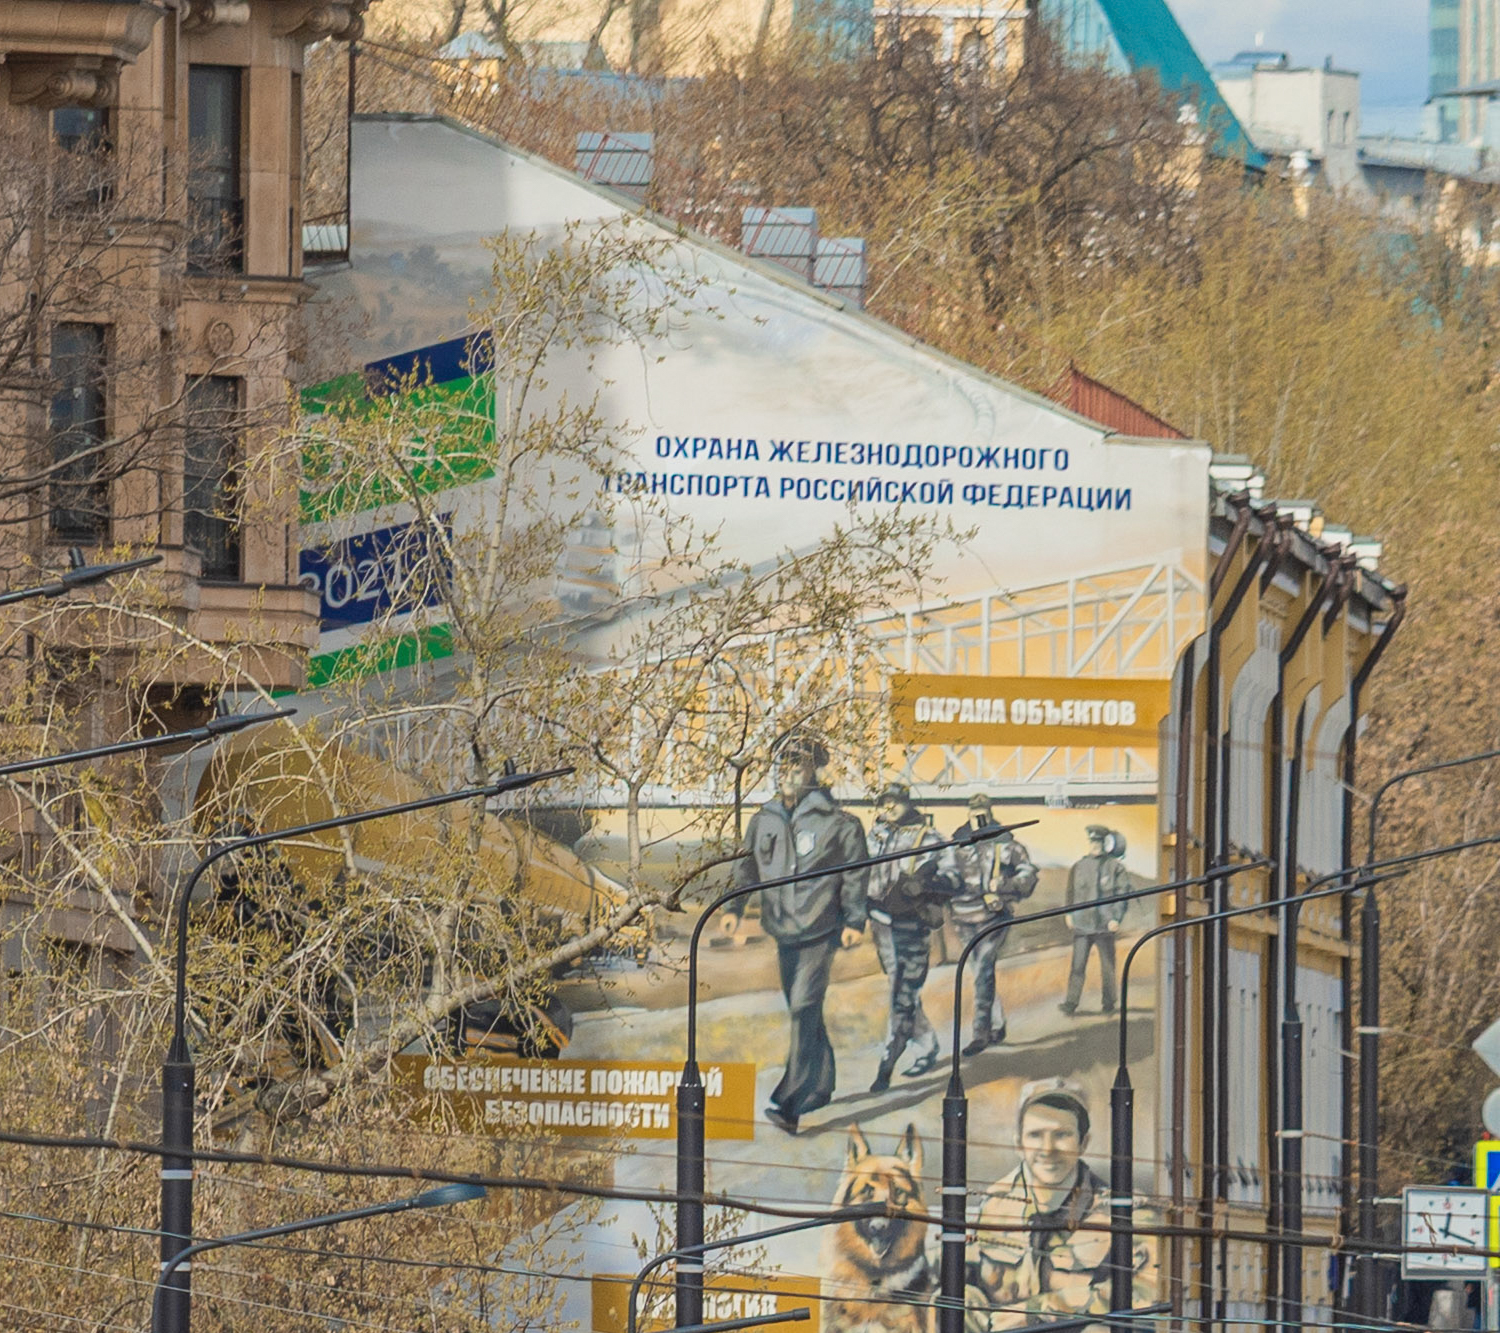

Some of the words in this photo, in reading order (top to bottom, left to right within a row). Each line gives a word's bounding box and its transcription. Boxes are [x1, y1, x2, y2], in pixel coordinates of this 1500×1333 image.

[654, 434, 760, 463] ОХРАНА
[767, 438, 1070, 471] ЖЕЛЕЗНОДОРОЖНОГО
[779, 476, 954, 506] РОССИЙСКОЙ
[961, 481, 1133, 512] ФЕДЕРАЦИИ
[914, 696, 1007, 724] ОХРАНА
[1010, 698, 1137, 726] ОБЪЕКТОВ
[590, 1067, 723, 1098] ПОЖАРЙ
[484, 1099, 671, 1129] БЕЗОПАСНОСТИ
